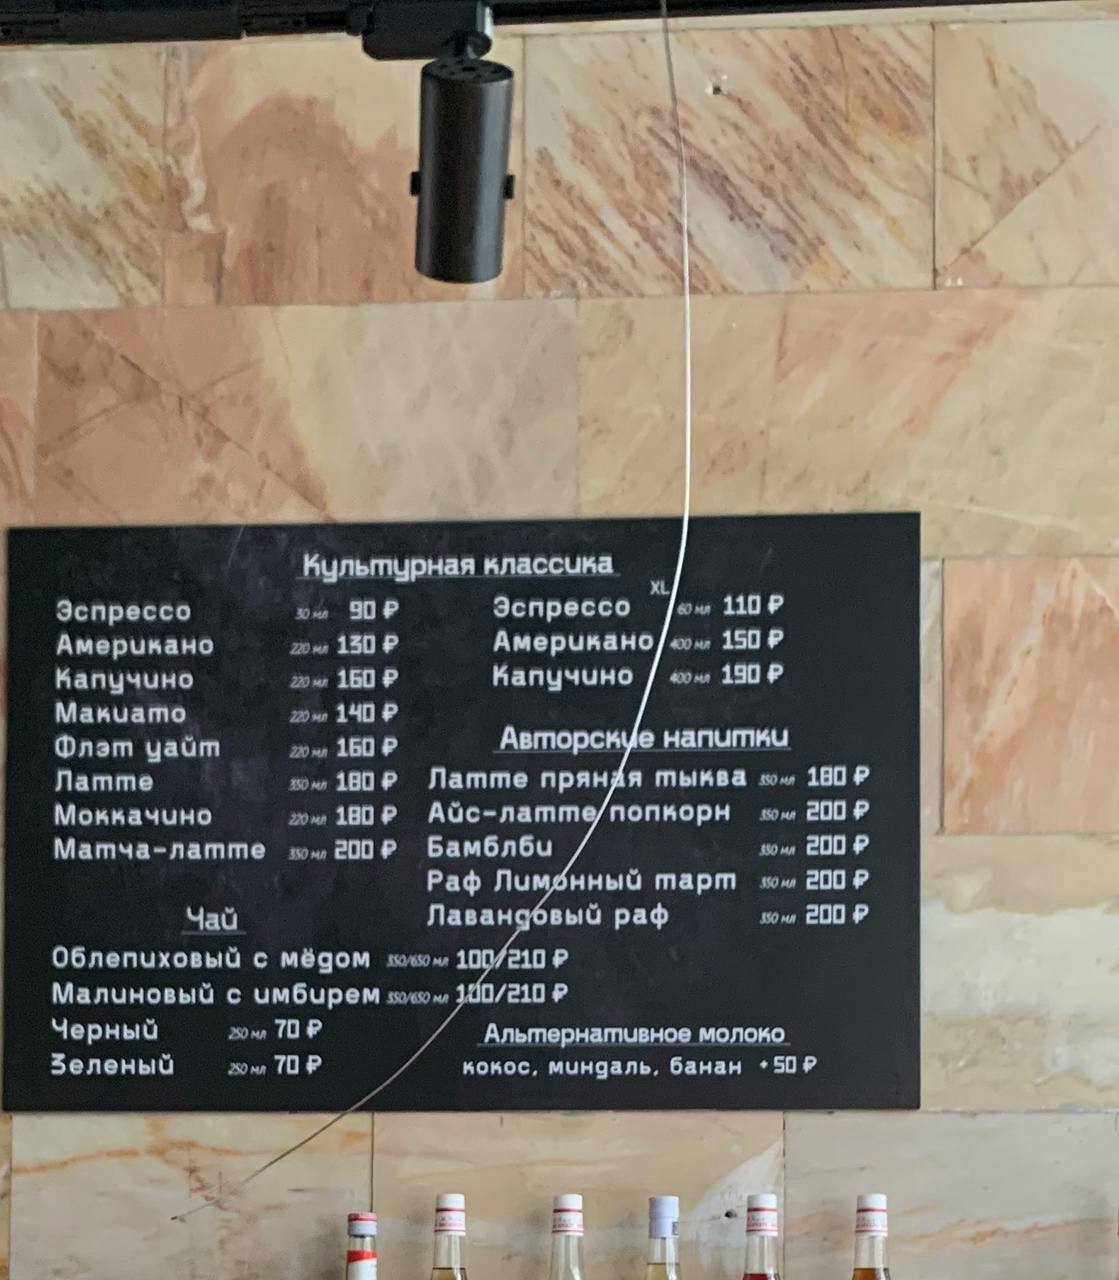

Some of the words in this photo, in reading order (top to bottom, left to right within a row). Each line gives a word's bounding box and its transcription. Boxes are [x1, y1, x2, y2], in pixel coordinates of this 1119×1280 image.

[304, 553, 475, 583] Культурная
[484, 556, 613, 576] классика
[651, 581, 670, 597] XL
[57, 600, 190, 626] Эспрессо
[312, 610, 328, 619] мл
[350, 601, 376, 620] 90
[494, 596, 630, 622] Эспрессо
[695, 605, 711, 614] мл
[724, 595, 761, 615] 110
[57, 634, 213, 660] Американо
[312, 645, 328, 654] мл
[494, 630, 654, 656] Американо
[694, 640, 711, 649] мл
[723, 630, 760, 649] 150
[56, 668, 193, 694] Капучино
[313, 678, 328, 688] мл
[493, 665, 633, 691] Капучино
[694, 674, 710, 683] мл
[722, 664, 760, 684] 190
[56, 702, 186, 723] Макиато
[312, 713, 328, 722] мл
[337, 703, 375, 723] 140
[55, 735, 133, 758] Флэт
[146, 736, 219, 763] уайт
[312, 748, 328, 758] мл
[500, 726, 654, 753] Авторские
[664, 729, 788, 748] напитки
[55, 770, 153, 791] Латте
[312, 781, 327, 790] мл
[337, 771, 374, 791] 180
[429, 767, 528, 789] Латте
[541, 769, 643, 794] пряная
[656, 770, 746, 787] тыква
[780, 776, 795, 785] мл
[808, 766, 846, 786] 180
[55, 804, 212, 825] Моккачино
[311, 815, 327, 825] мл
[336, 806, 374, 825] 180
[429, 802, 597, 824] Айс-латте
[610, 804, 730, 826] попкорн
[781, 811, 796, 820] мл
[807, 800, 846, 820] 200
[55, 838, 265, 859] Матча-латте
[311, 850, 327, 860] мл
[335, 840, 373, 859] 200
[428, 835, 552, 857] Бамблби
[780, 846, 795, 855] мл
[807, 835, 846, 855] 200
[428, 870, 481, 896] Раф
[494, 868, 641, 892] Лимонный
[656, 873, 736, 893] тарт
[781, 879, 796, 888] мл
[806, 870, 845, 890] 200
[187, 907, 237, 931] Чай
[427, 903, 601, 931] Лавандовый
[615, 903, 668, 930] раф
[781, 915, 796, 923] мл
[806, 904, 845, 924] 200
[53, 946, 240, 968] Облепиховый
[254, 952, 267, 968] с
[281, 948, 369, 973] мёдом
[433, 957, 449, 966] мл
[53, 982, 213, 1004] Малиновый
[227, 988, 241, 1004] с
[254, 983, 379, 1009] имбирем
[433, 994, 449, 1003] мл
[52, 1018, 157, 1044] Черный
[252, 1030, 266, 1039] мл
[275, 1019, 299, 1038] 70
[485, 1023, 691, 1048] Альтернативное
[699, 1028, 785, 1044] молоко
[52, 1053, 173, 1075] Зеленый
[252, 1065, 266, 1074] мл
[274, 1055, 299, 1074] 70
[463, 1061, 537, 1076] кокос,
[549, 1061, 658, 1079] миндаль,
[670, 1057, 741, 1075] банан
